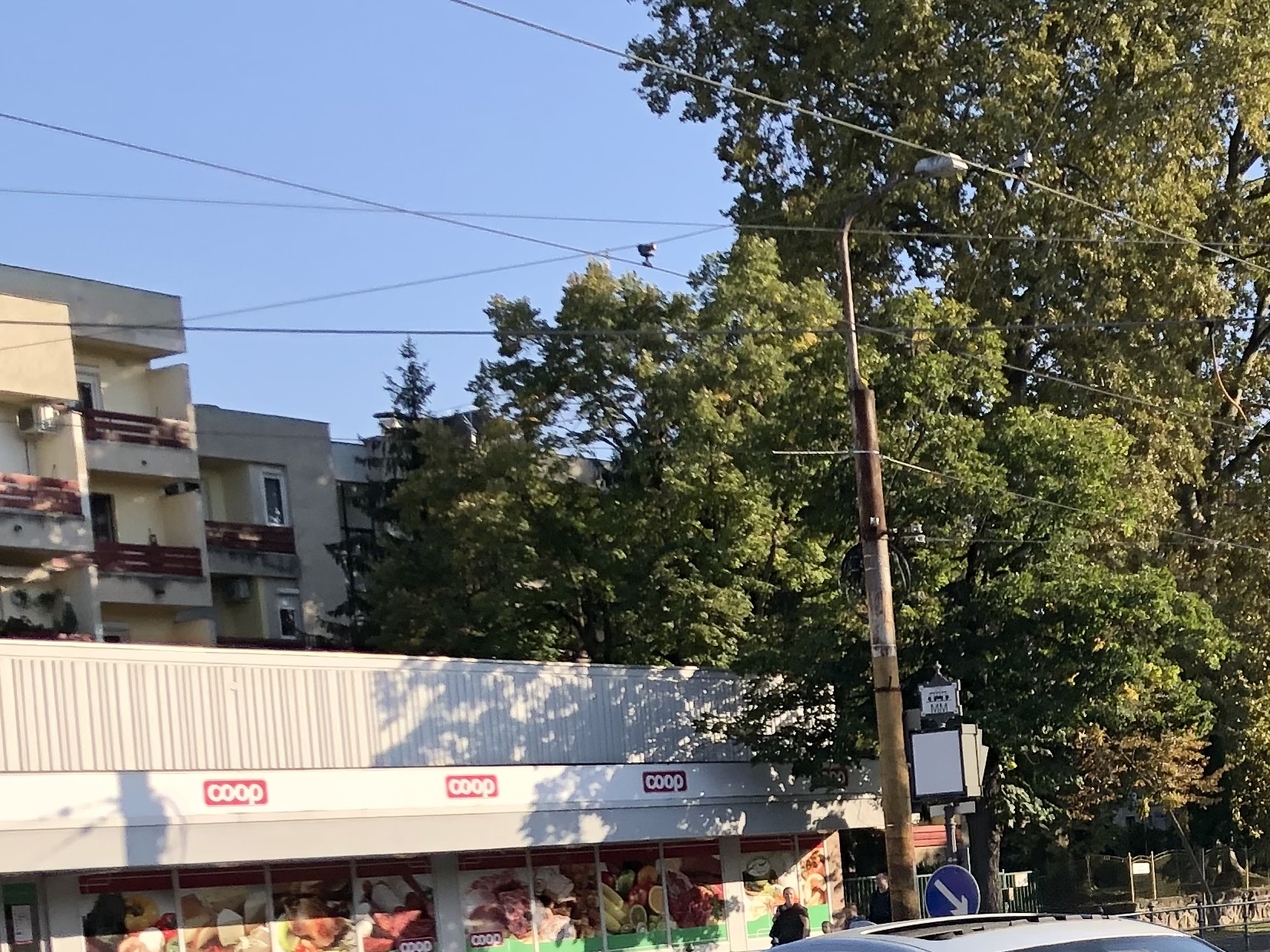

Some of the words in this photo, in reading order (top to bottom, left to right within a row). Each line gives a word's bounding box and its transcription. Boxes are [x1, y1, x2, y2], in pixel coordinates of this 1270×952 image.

[448, 778, 496, 798] coop
[645, 774, 684, 792] coop
[207, 784, 264, 805] coop
[470, 933, 502, 947] coop
